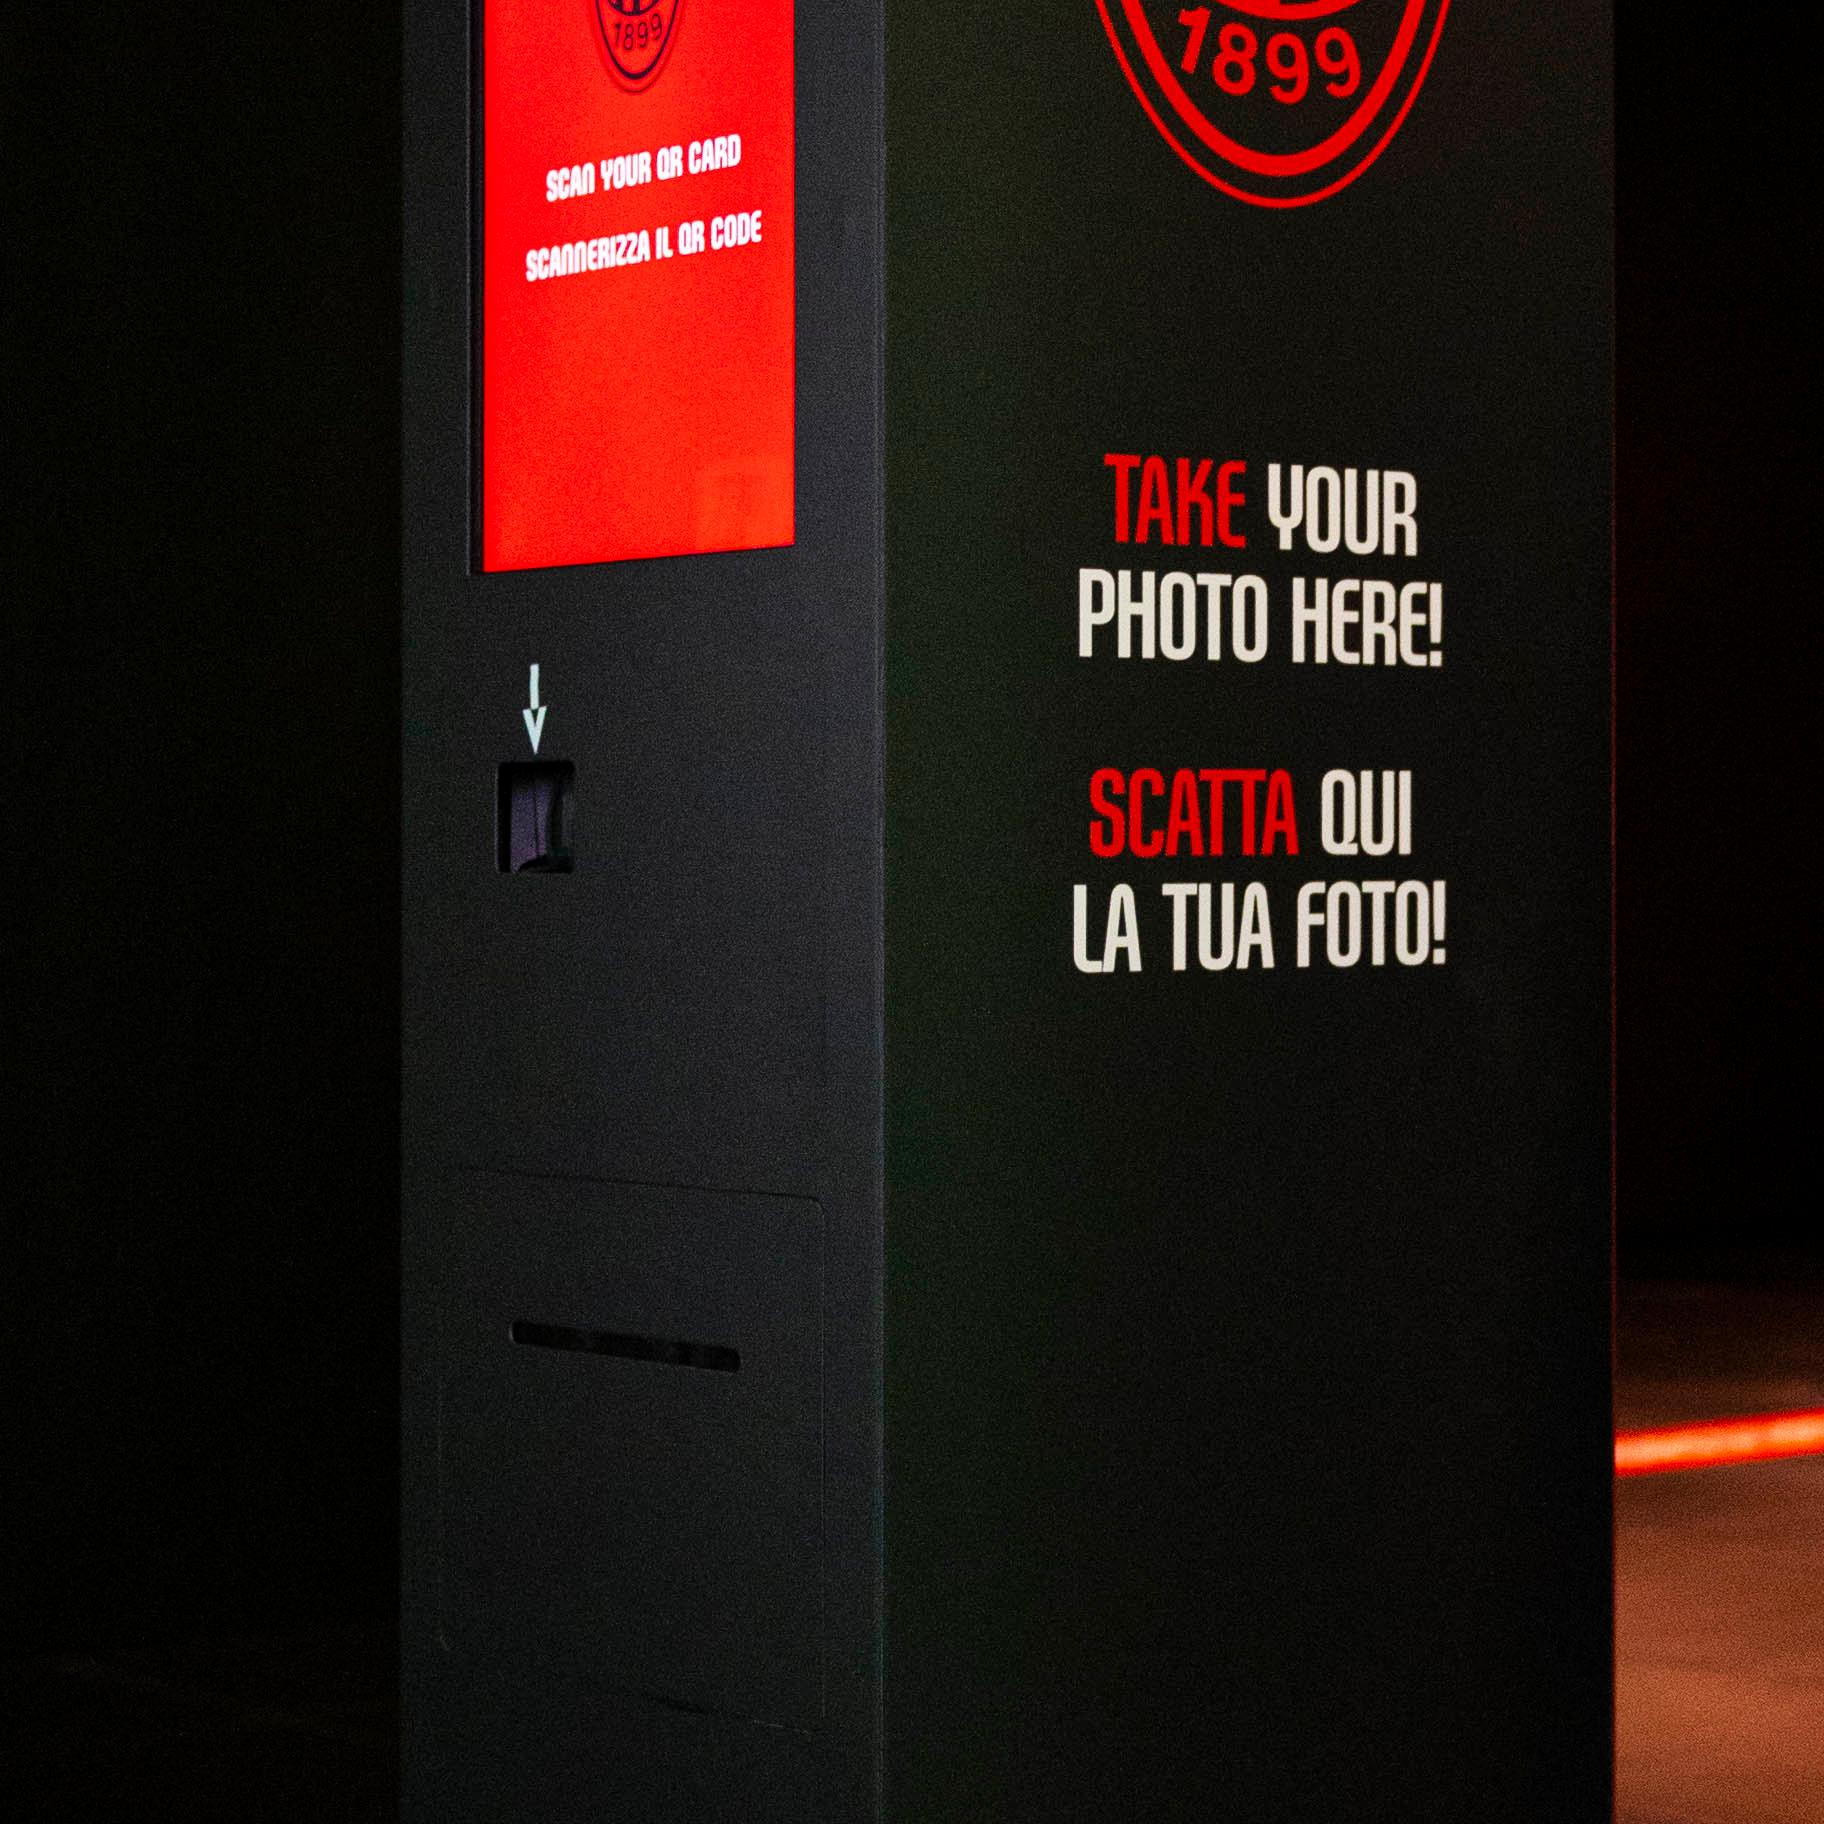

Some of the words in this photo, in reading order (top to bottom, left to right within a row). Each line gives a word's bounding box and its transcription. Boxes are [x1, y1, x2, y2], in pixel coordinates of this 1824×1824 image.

[614, 13, 663, 51] 1899
[1177, 5, 1361, 105] 1899
[546, 162, 595, 202] SCAN
[600, 151, 651, 191] YOUR
[656, 145, 683, 180] QR
[688, 133, 741, 174] CARD
[526, 230, 650, 282] SCANNERIZZA
[655, 226, 673, 259] IL
[678, 220, 705, 255] QR
[710, 210, 762, 250] CODE
[1104, 452, 1247, 548] TAKE
[1268, 463, 1418, 557] YOUR
[1078, 568, 1268, 663] PHOTO
[1292, 577, 1443, 667] HERE!
[1089, 767, 1299, 858] SCATTA
[1321, 769, 1412, 856] QUI
[1073, 883, 1142, 974] LA
[1162, 881, 1275, 972] TUA
[1297, 880, 1447, 968] FOTO!
